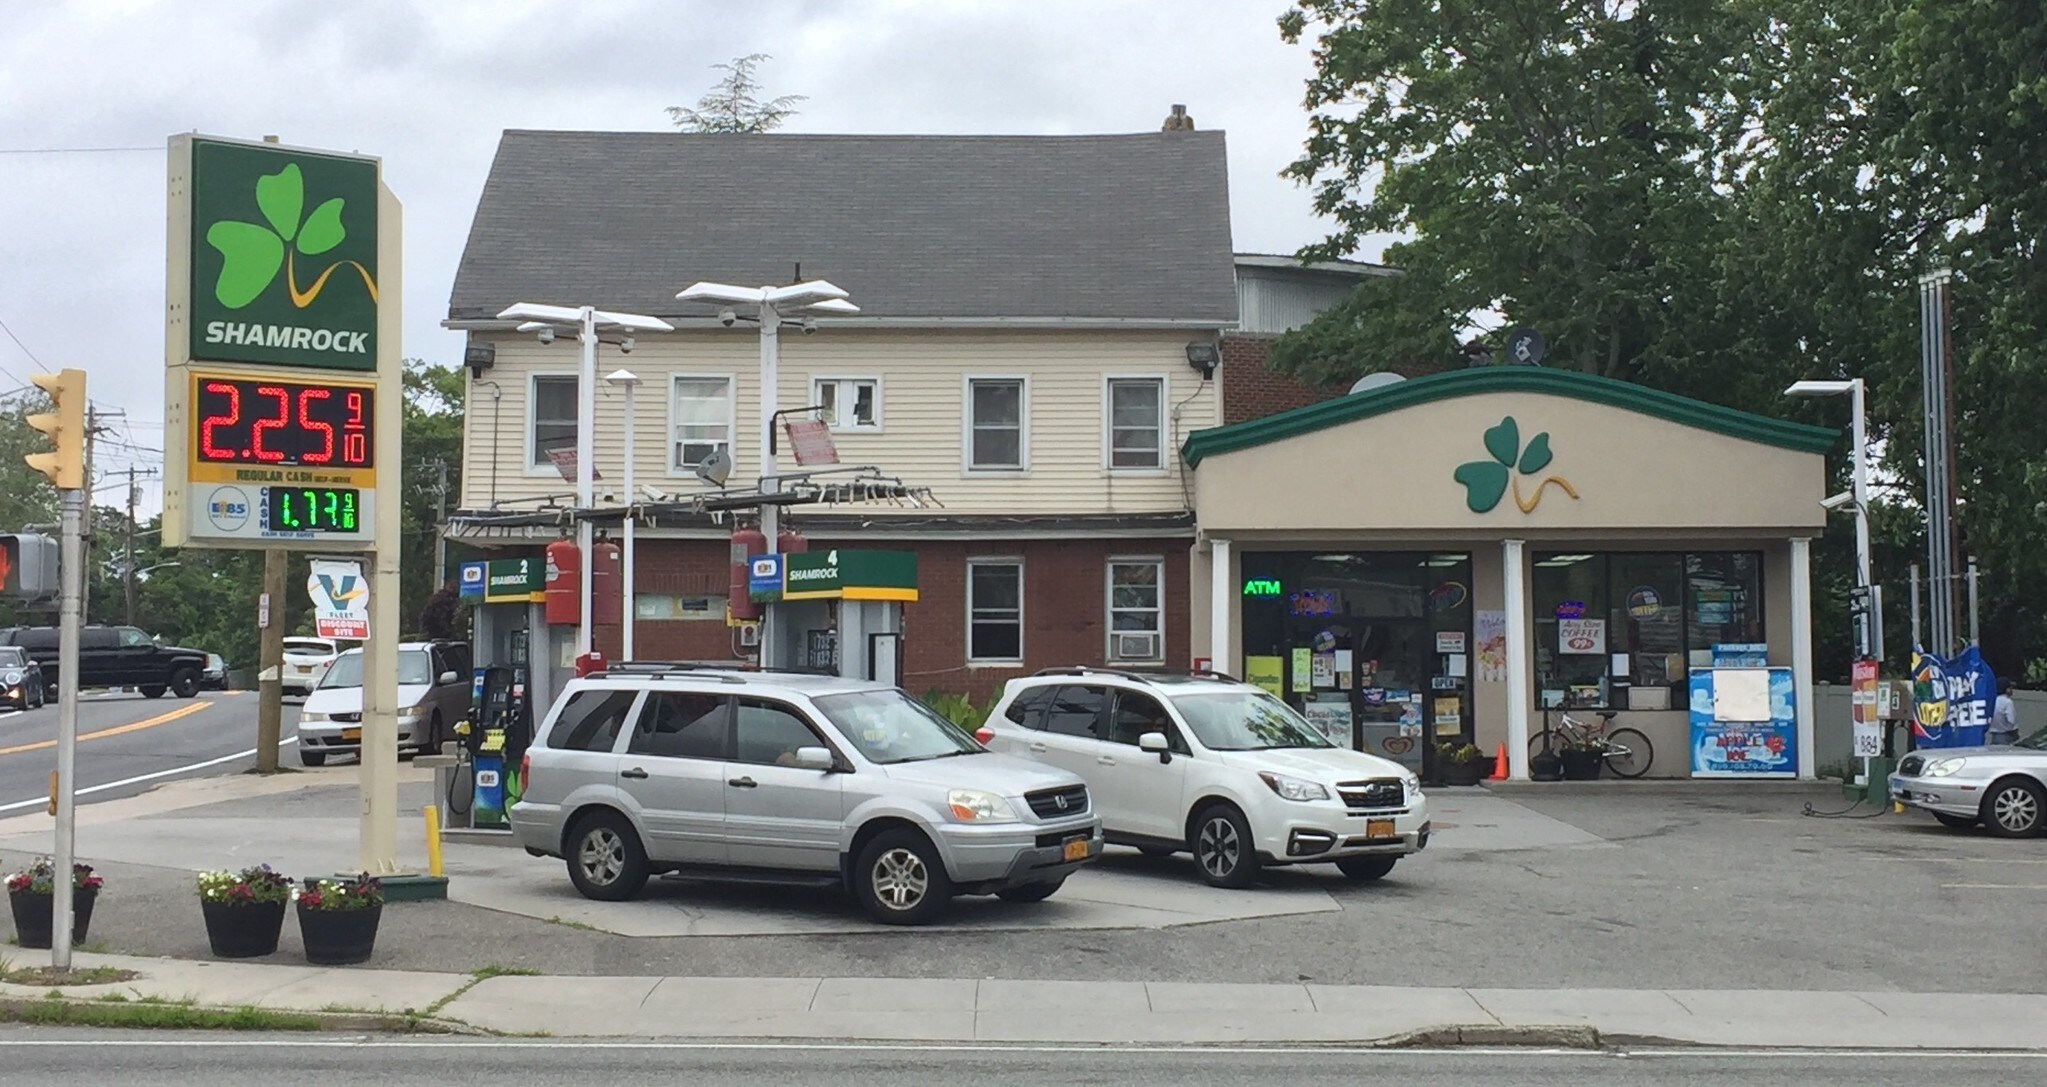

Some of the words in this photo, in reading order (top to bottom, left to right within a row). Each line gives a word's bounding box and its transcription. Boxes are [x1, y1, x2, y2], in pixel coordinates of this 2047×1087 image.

[205, 321, 369, 353] SHAMROCK
[202, 383, 334, 461] 2.25
[236, 469, 283, 482] REGULAR
[286, 471, 313, 482] CASH
[828, 550, 838, 566] 4
[520, 559, 528, 574] 2
[490, 575, 528, 586] SHAMROCK
[789, 567, 839, 581] SHAMROCK
[1244, 580, 1281, 595] ATM
[320, 620, 366, 629] DISCOUNT
[334, 628, 354, 636] SITE
[1561, 629, 1600, 638] COFFEE
